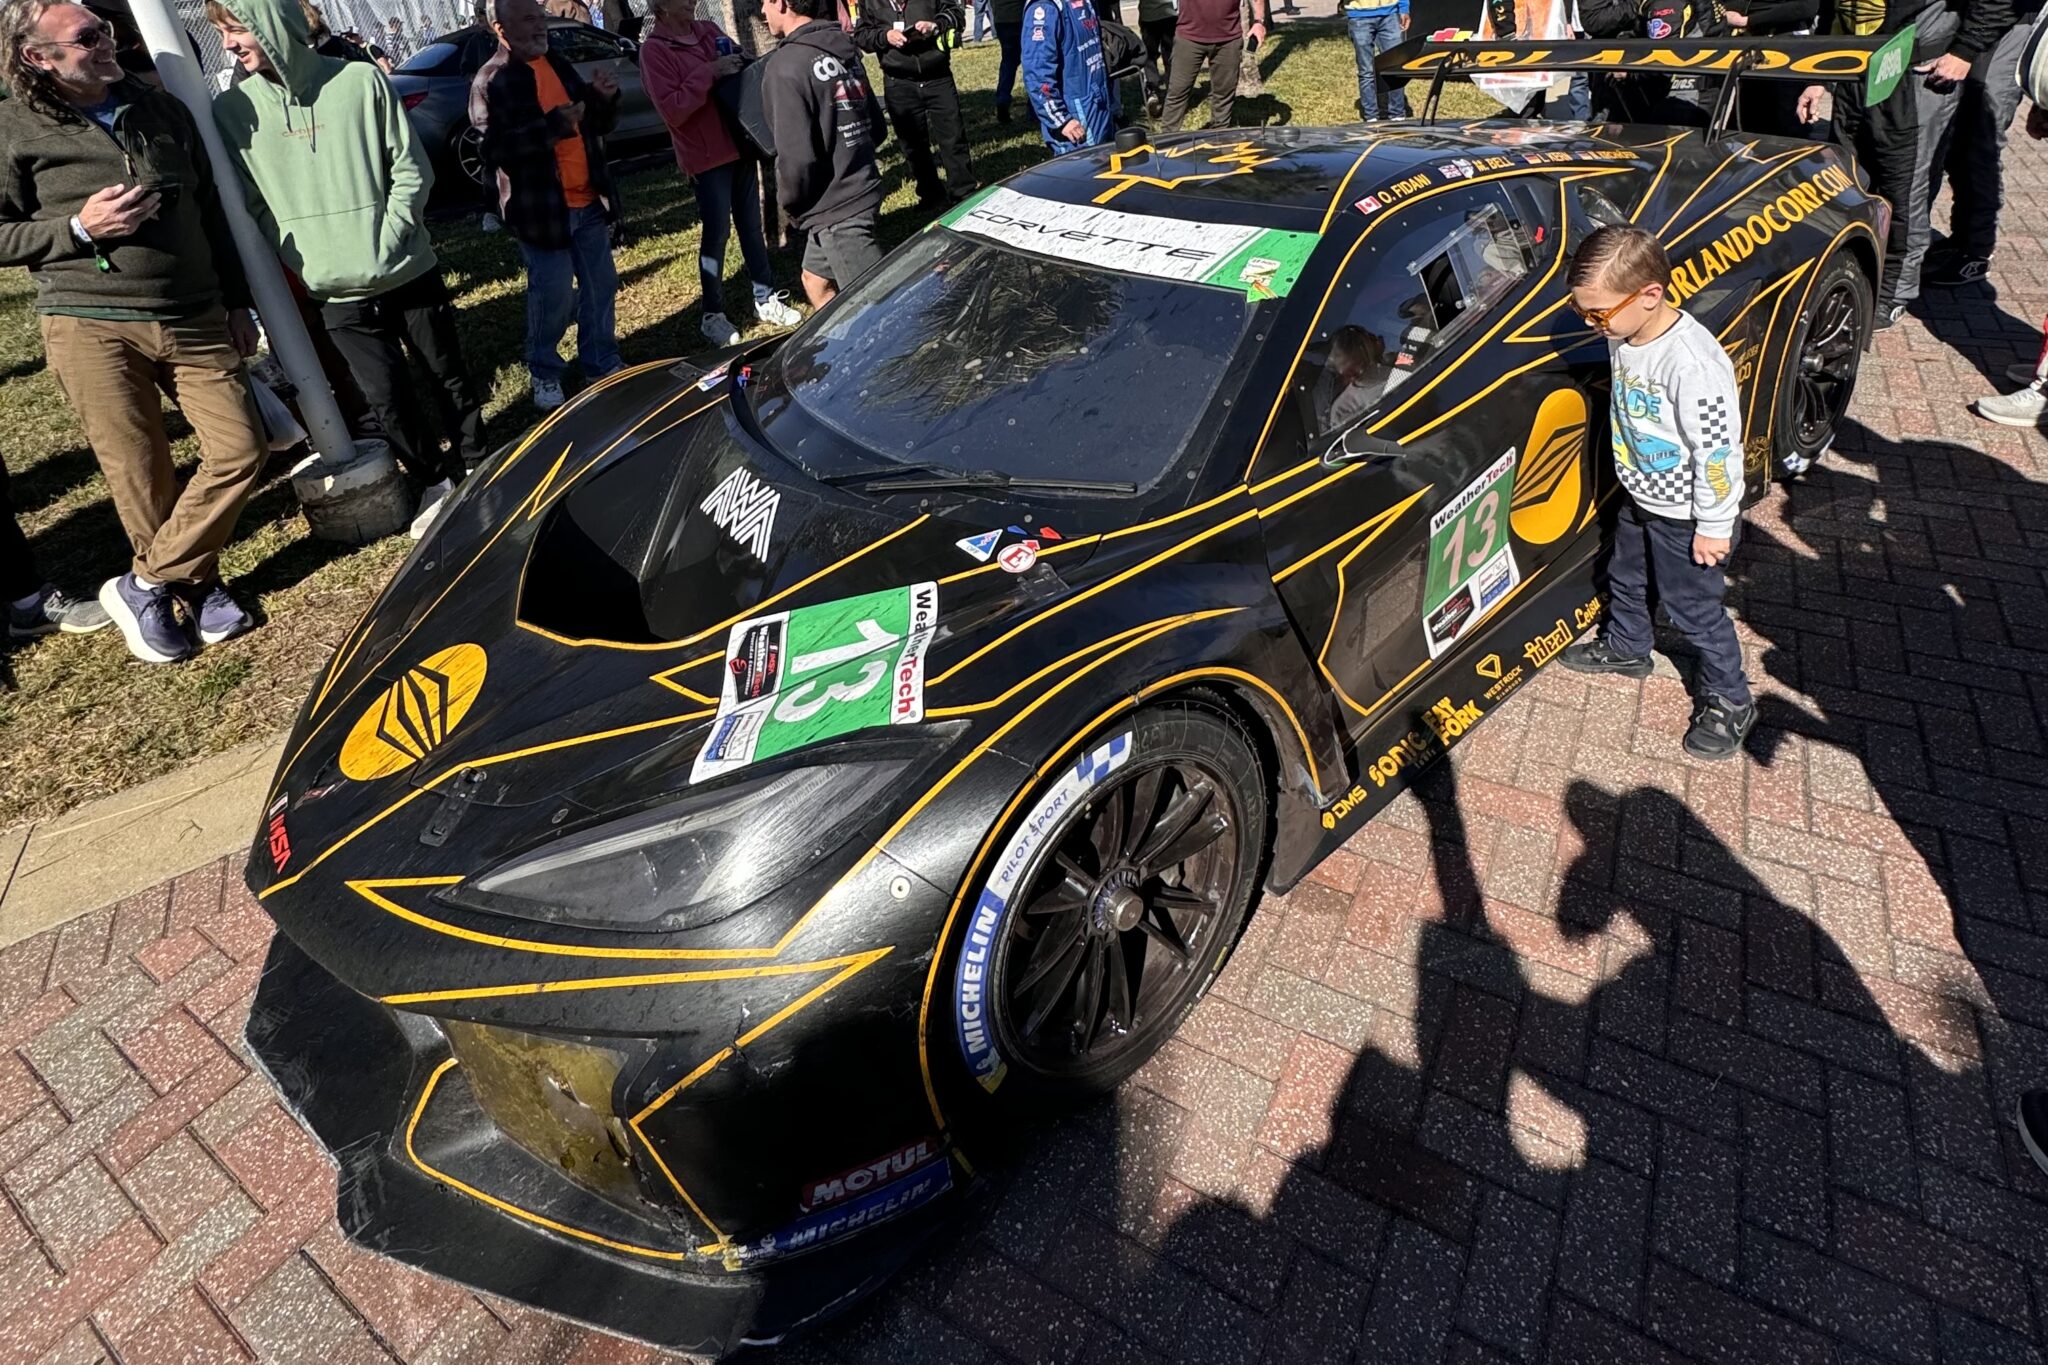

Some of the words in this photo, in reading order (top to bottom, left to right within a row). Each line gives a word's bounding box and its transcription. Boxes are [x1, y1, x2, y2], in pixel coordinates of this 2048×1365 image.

[1402, 49, 1873, 74] ORLANDO
[1377, 190, 1396, 204] O.
[1390, 173, 1432, 198] FIDANI
[1485, 156, 1516, 170] BELL
[970, 209, 1217, 261] CORVETTE
[1614, 379, 1661, 424] RCE
[1434, 454, 1513, 529] WeatherTech
[1003, 547, 1031, 568] E
[1442, 490, 1499, 589] 13
[773, 619, 899, 722] 13
[898, 589, 931, 714] WeatherTech
[1483, 665, 1523, 699] WESTROCK
[1435, 700, 1484, 746] FORK
[1368, 731, 1427, 787] SONIC
[1332, 785, 1367, 819] DMS
[269, 813, 291, 875] IMSA
[1001, 835, 1030, 883] PILOT
[1031, 788, 1070, 837] SPORT
[962, 905, 999, 1055] MICHELIN
[811, 1142, 933, 1206] MOTUL
[789, 1178, 932, 1249] MICHELIN
